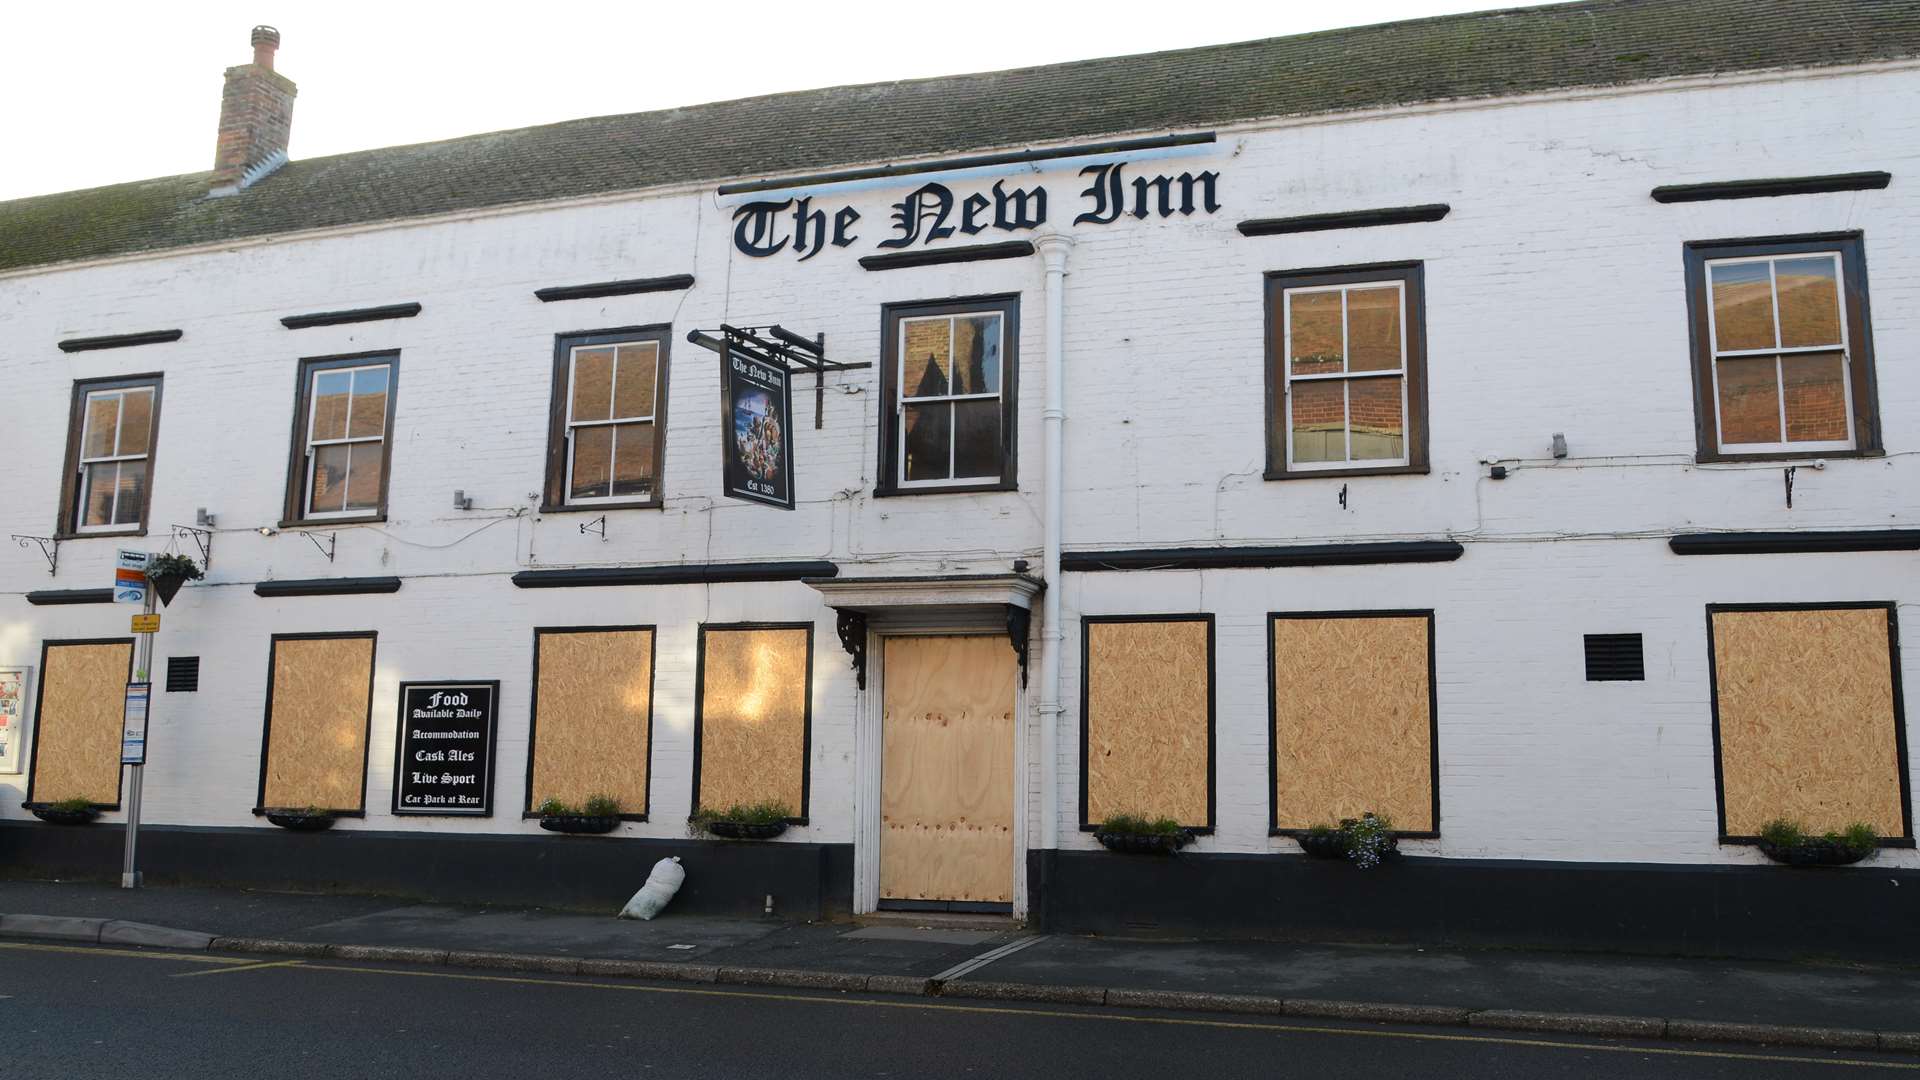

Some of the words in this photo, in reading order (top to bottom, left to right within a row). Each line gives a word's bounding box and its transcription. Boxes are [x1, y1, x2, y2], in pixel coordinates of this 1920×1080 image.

[732, 195, 861, 262] The
[877, 179, 1047, 248] New
[1073, 161, 1221, 226] Inn
[732, 357, 747, 373] The
[748, 364, 767, 381] New
[767, 370, 782, 387] Inn
[747, 480, 758, 492] Est
[427, 692, 468, 709] Food
[412, 709, 454, 718] Available
[456, 709, 482, 719] Daily
[412, 729, 480, 739] Accommodation
[415, 750, 445, 761] Cask
[448, 749, 475, 761] Ales
[412, 771, 438, 784] Live
[440, 772, 475, 786] Sport
[405, 794, 421, 803] Car
[423, 794, 445, 805] Park
[458, 795, 480, 804] Rear
